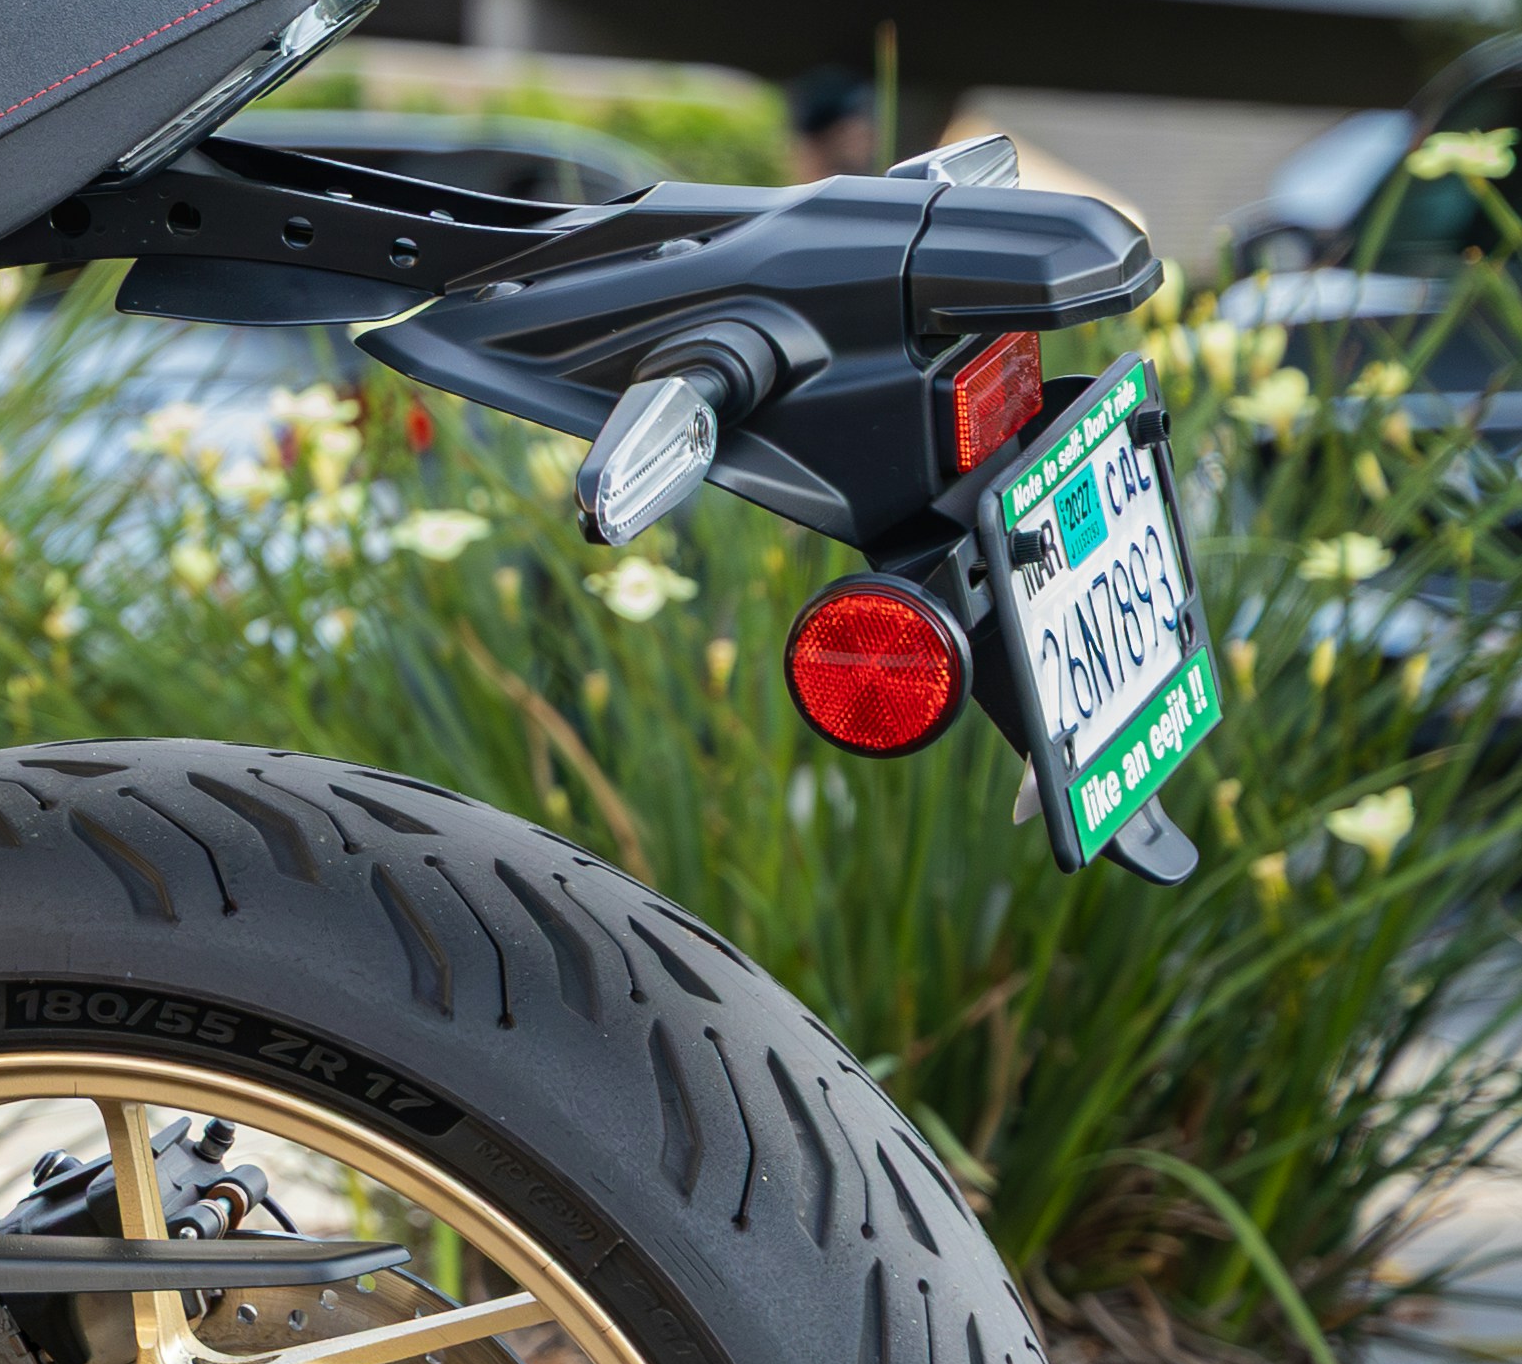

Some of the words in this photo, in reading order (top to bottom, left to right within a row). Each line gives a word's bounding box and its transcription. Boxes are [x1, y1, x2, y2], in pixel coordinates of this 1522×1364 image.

[1012, 473, 1043, 516] Note
[1043, 459, 1058, 486] to
[1083, 398, 1115, 447] Don't
[1114, 379, 1137, 417] ride
[1065, 479, 1092, 531] 2027
[1105, 446, 1151, 516] CAL
[1043, 525, 1177, 734] 26N7893
[1081, 771, 1123, 832] like
[1122, 740, 1151, 790] an
[1149, 683, 1193, 759] eejit
[1187, 664, 1208, 715] !!
[14, 988, 242, 1046] 180/55
[256, 1026, 350, 1084] ZR
[364, 1070, 439, 1114] 17
